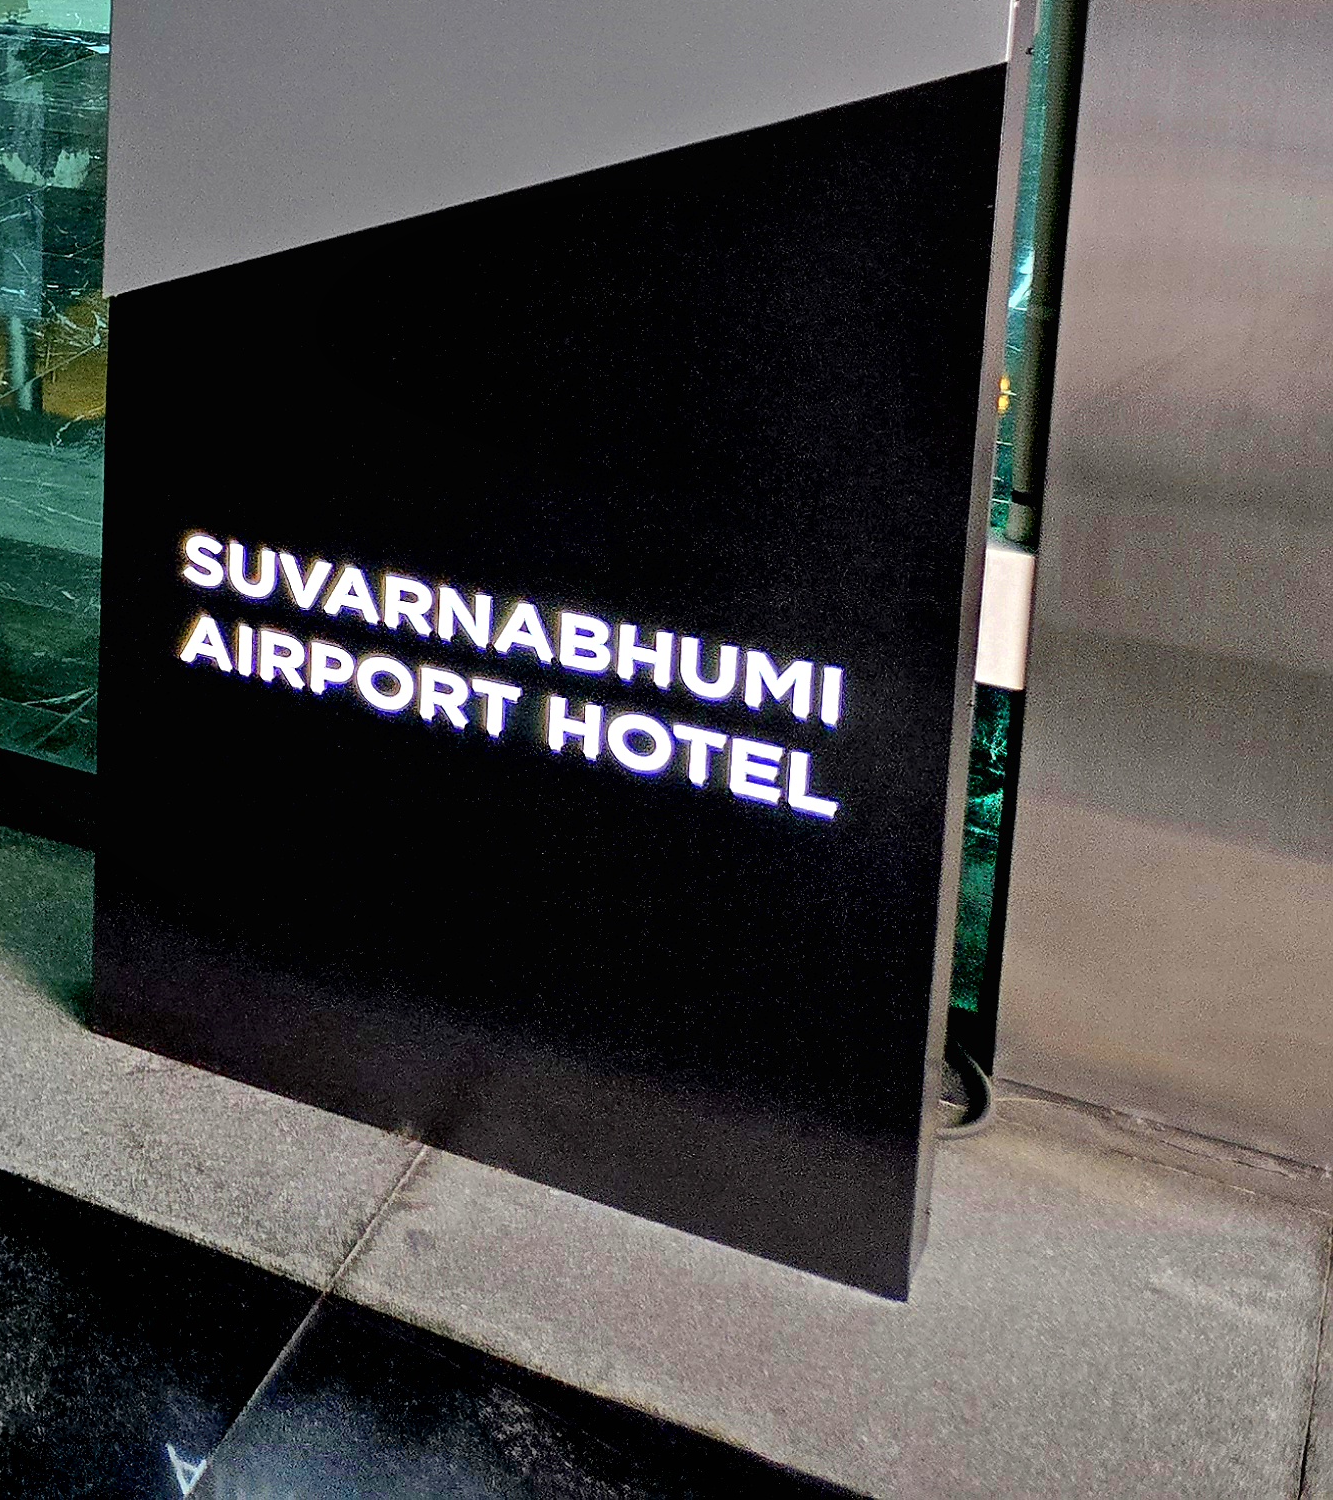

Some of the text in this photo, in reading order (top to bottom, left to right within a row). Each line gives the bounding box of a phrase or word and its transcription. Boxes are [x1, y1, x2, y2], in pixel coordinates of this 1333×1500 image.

[178, 614, 839, 819] AIRPORT HOTEL
[181, 533, 844, 728] SUVARNABHUMI
